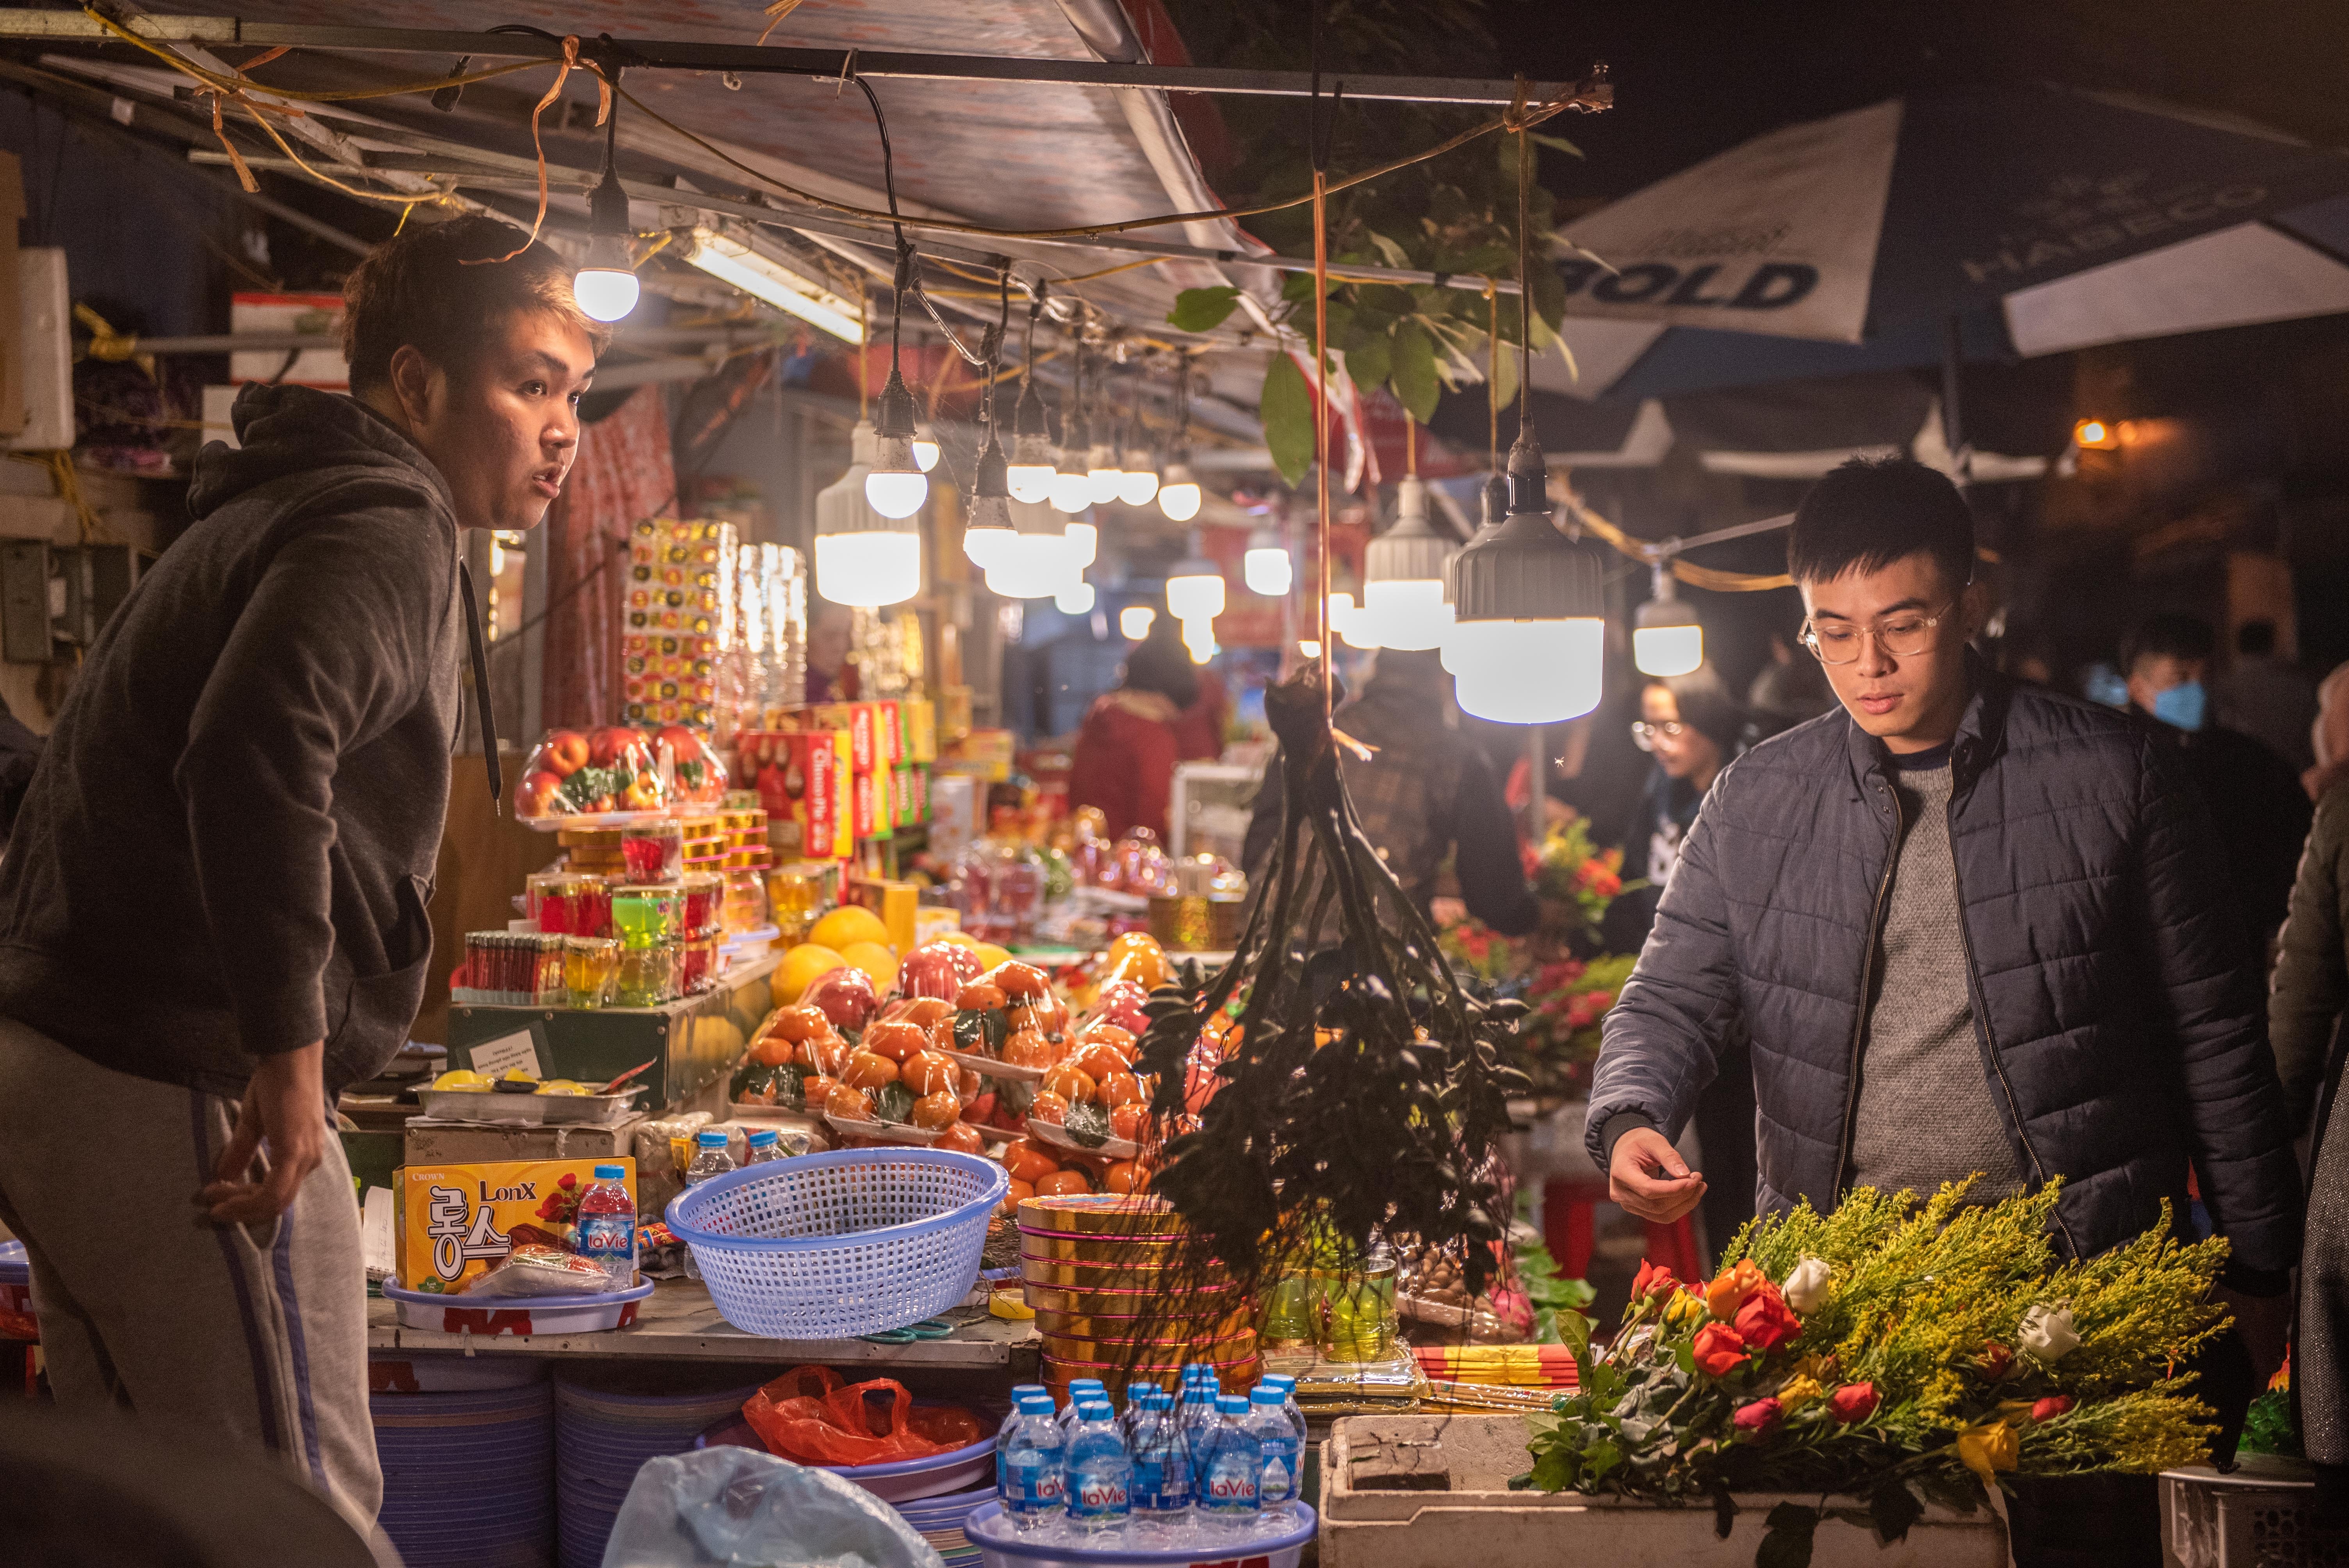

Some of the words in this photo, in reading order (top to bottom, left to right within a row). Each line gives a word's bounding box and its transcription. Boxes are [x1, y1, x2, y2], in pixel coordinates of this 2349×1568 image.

[412, 1173, 445, 1181] CROWN
[479, 1180, 537, 1203] LonX
[588, 1233, 628, 1248] laVie
[1037, 1478, 1064, 1497] laV
[1082, 1487, 1126, 1506] laVie
[1210, 1479, 1255, 1497] laVie
